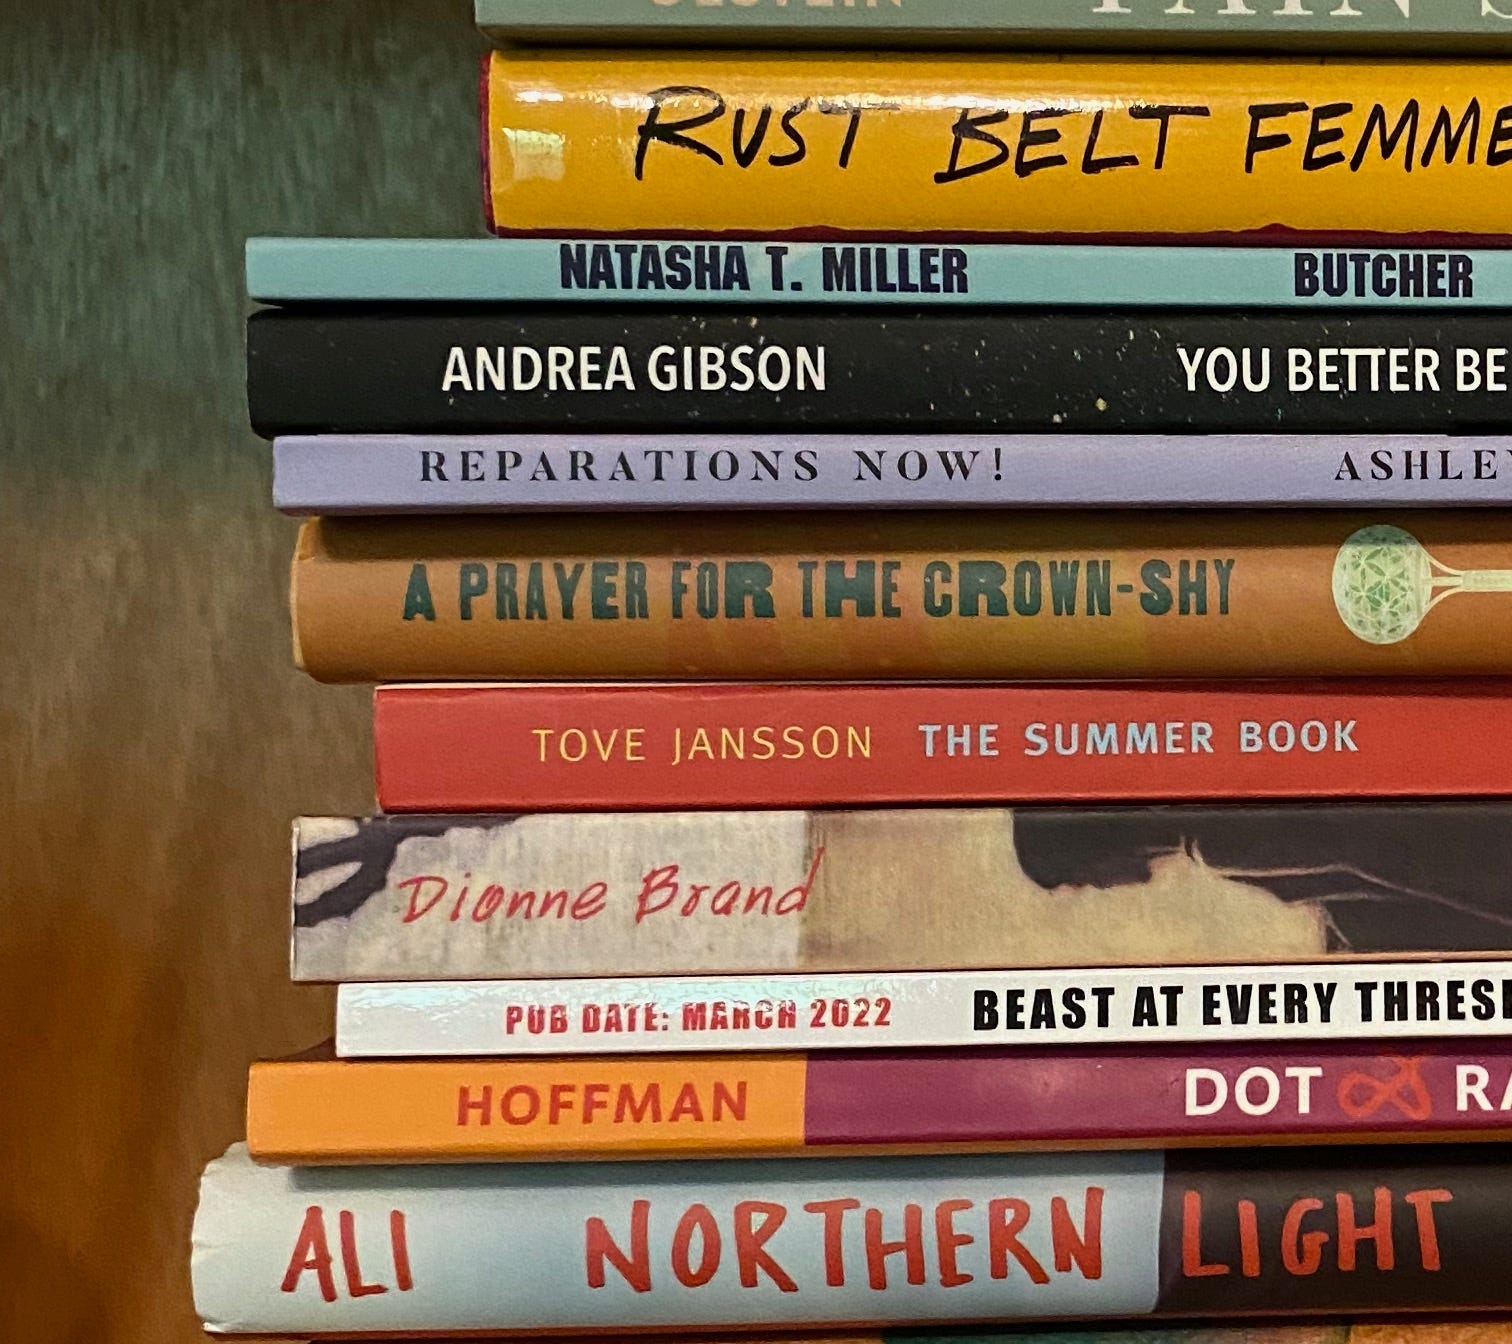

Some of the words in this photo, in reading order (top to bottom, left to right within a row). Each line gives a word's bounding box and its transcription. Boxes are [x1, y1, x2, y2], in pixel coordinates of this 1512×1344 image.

[634, 85, 900, 181] RUST
[933, 105, 1211, 183] BELT
[560, 243, 751, 290] NATASHA
[765, 246, 802, 292] T.
[822, 246, 968, 294] MILLER
[1294, 252, 1473, 298] BUTCHER
[441, 344, 635, 392] ANDREA
[648, 345, 825, 392] GIBSON
[1177, 347, 1272, 392] YOU
[1287, 347, 1440, 392] BETTER
[1456, 347, 1506, 392] BE
[420, 448, 819, 483] REPARATIONS
[855, 446, 1004, 482] NOW!
[402, 562, 436, 622] A
[459, 560, 649, 622] PRAYER
[670, 560, 776, 620] FOR
[798, 559, 901, 620] THE
[923, 558, 1235, 618] CROWN-SHY
[532, 728, 645, 763] TOVE
[671, 725, 872, 765] JANSSON
[919, 723, 999, 757] THE
[1024, 720, 1214, 757] SUMMER
[1240, 719, 1358, 754] BOOK
[397, 870, 608, 923] Dionne
[635, 847, 826, 924] Brand
[506, 1004, 568, 1035] PUB
[582, 1002, 669, 1033] DATE:
[682, 999, 797, 1031] MARCH
[809, 996, 891, 1028] 2022
[973, 986, 1115, 1031] BEAST
[1132, 985, 1184, 1027] AT
[1202, 982, 1338, 1026] EVERY
[456, 1081, 748, 1126] HOFFMAN
[1185, 1066, 1322, 1116] DOT
[280, 1205, 413, 1302] ALI
[585, 1186, 1104, 1293] NORTHERN
[1181, 1186, 1453, 1278] LIGHT
